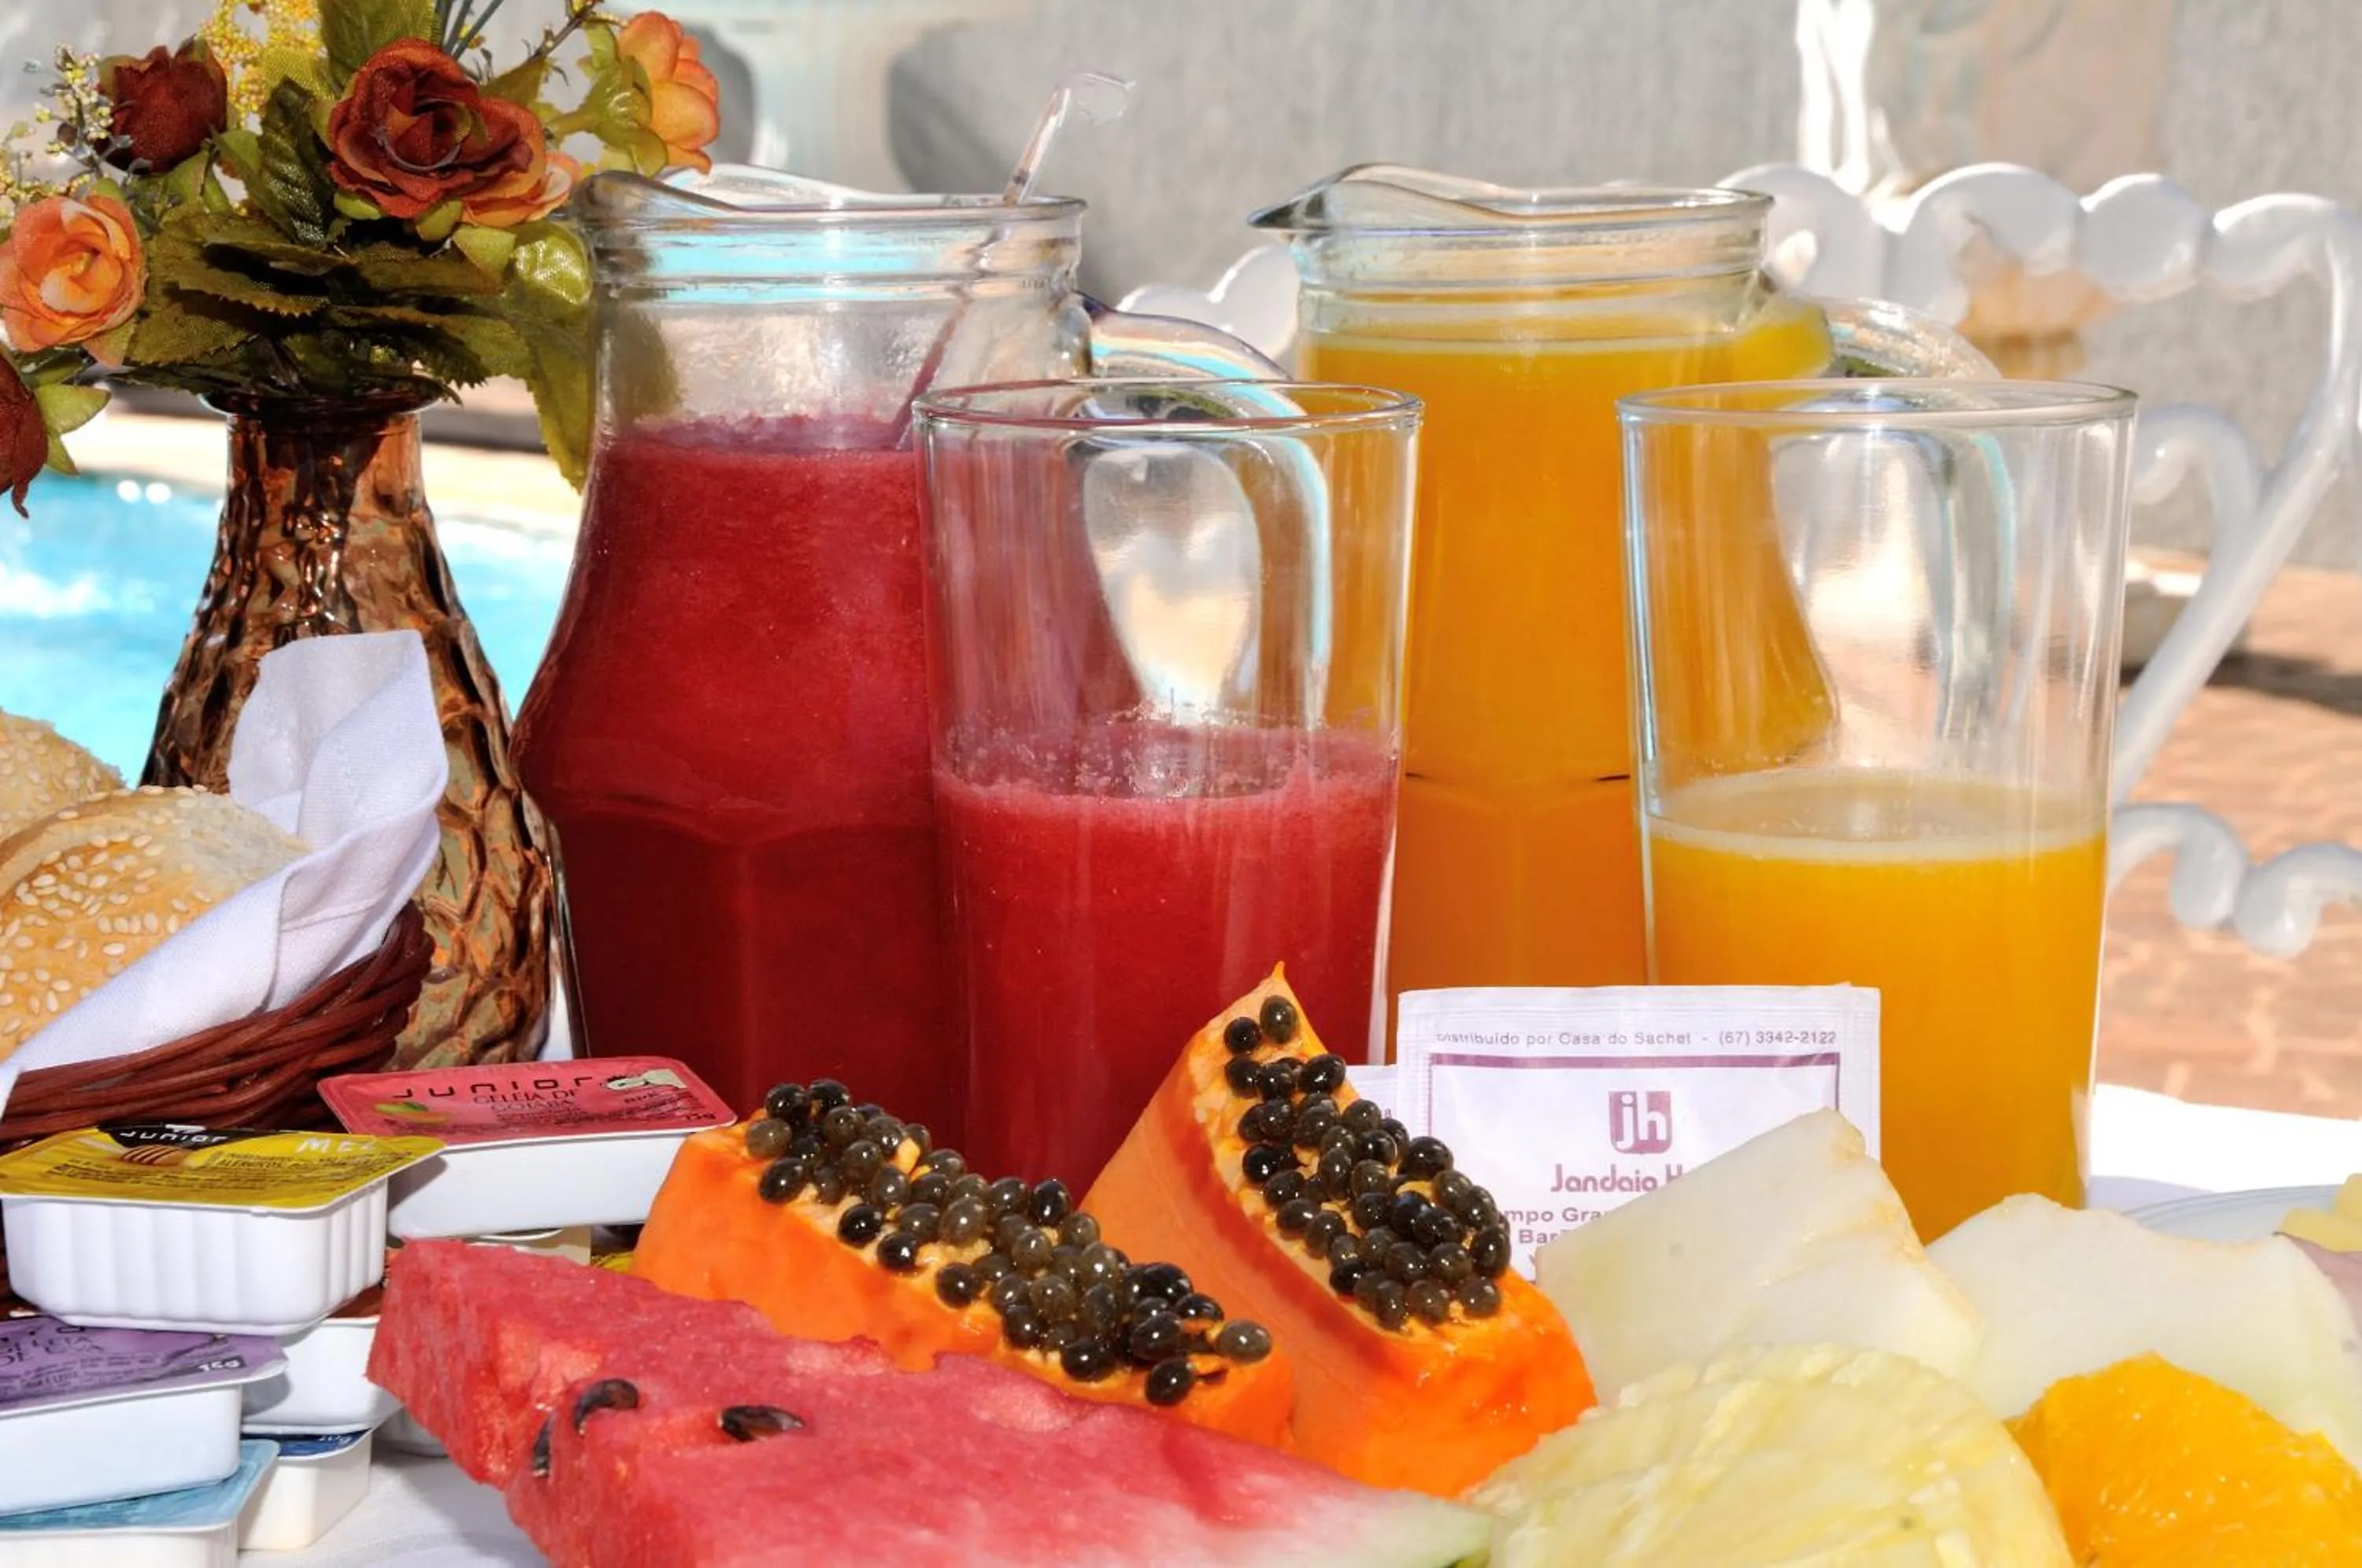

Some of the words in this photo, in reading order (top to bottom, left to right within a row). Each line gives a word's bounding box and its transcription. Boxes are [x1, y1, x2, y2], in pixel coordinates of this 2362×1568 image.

[1526, 1033, 1553, 1049] por
[1558, 1031, 1601, 1045] Casa
[1608, 1032, 1627, 1045] do
[1634, 1030, 1691, 1045] Sachet
[1719, 1030, 1751, 1048] (67)
[1756, 1030, 1837, 1045] 3342-2122
[1504, 1209, 1554, 1225] mpo
[1561, 1207, 1606, 1222] Gra
